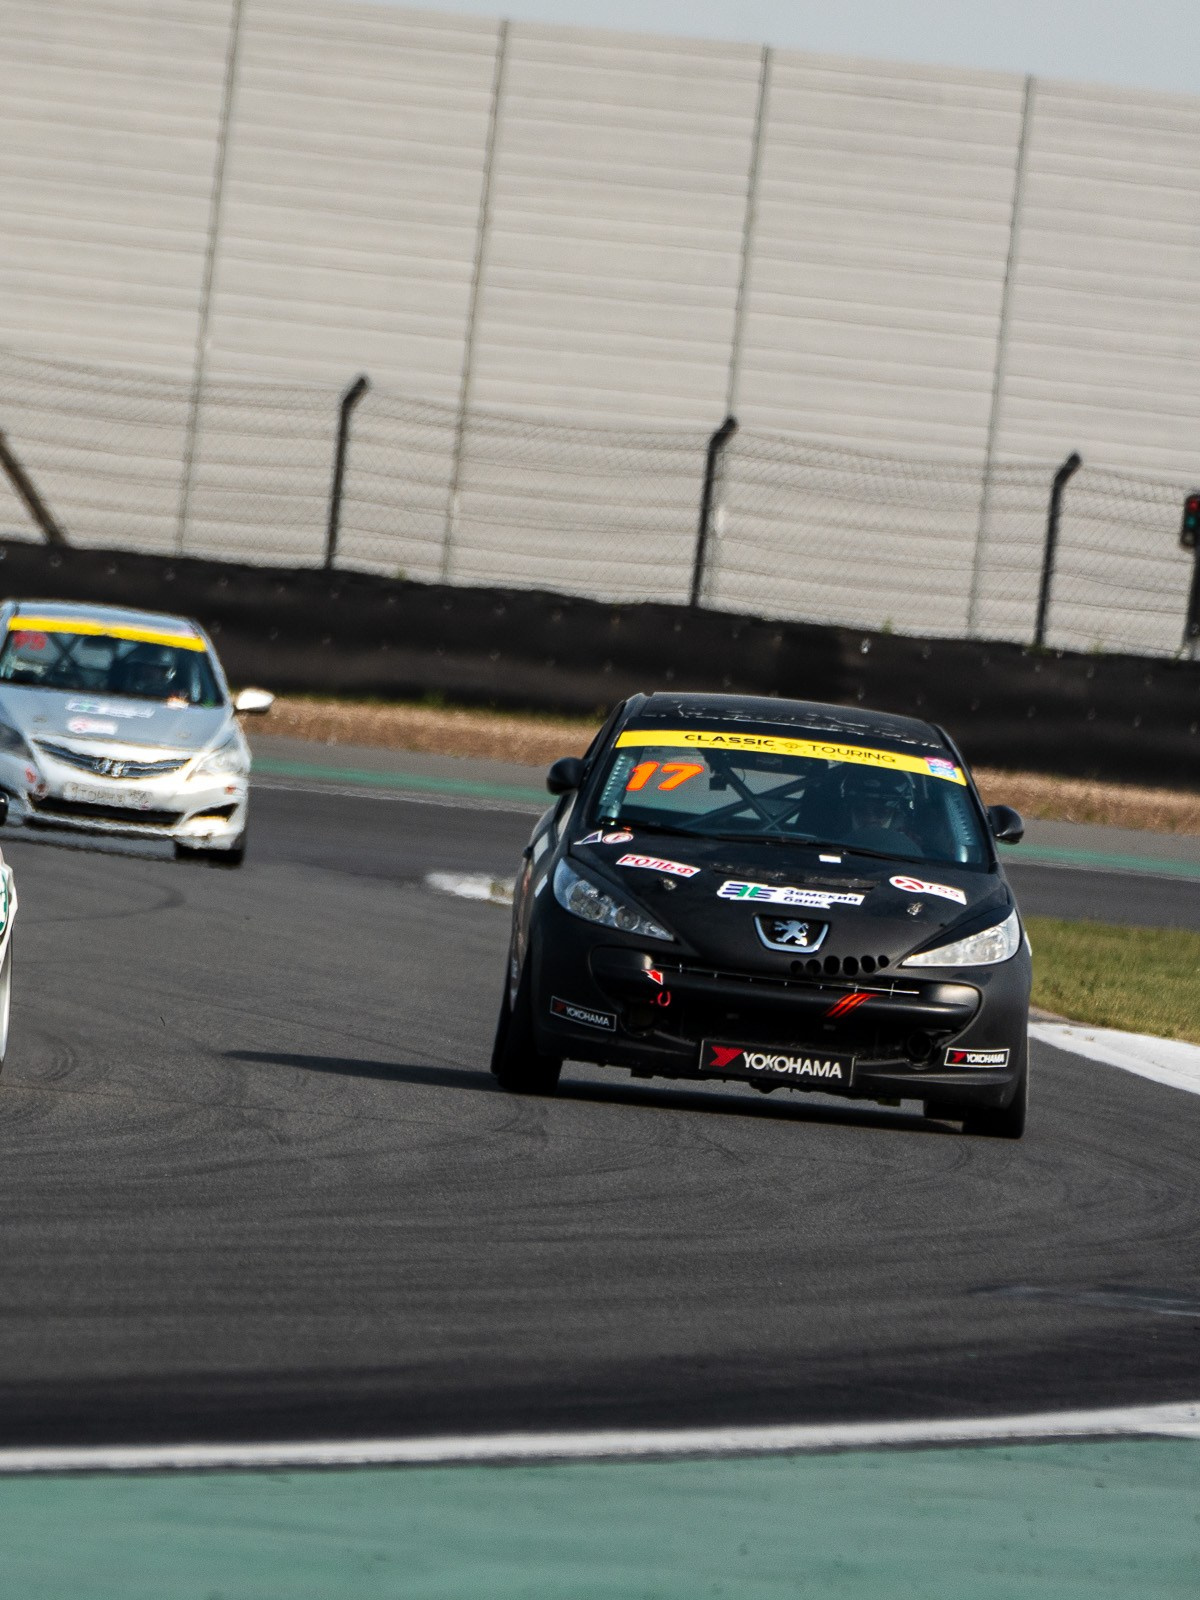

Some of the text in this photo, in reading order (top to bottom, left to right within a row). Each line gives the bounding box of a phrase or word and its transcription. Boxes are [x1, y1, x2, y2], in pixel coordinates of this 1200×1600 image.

[684, 734, 897, 763] CLASSIC TOURING
[625, 760, 704, 791] 17
[619, 856, 695, 875] РОЛЬФ
[565, 1006, 610, 1026] YOKOHAMA
[742, 1053, 843, 1079] YOKOHAMA
[966, 1053, 1005, 1063] YOKOHAMA
